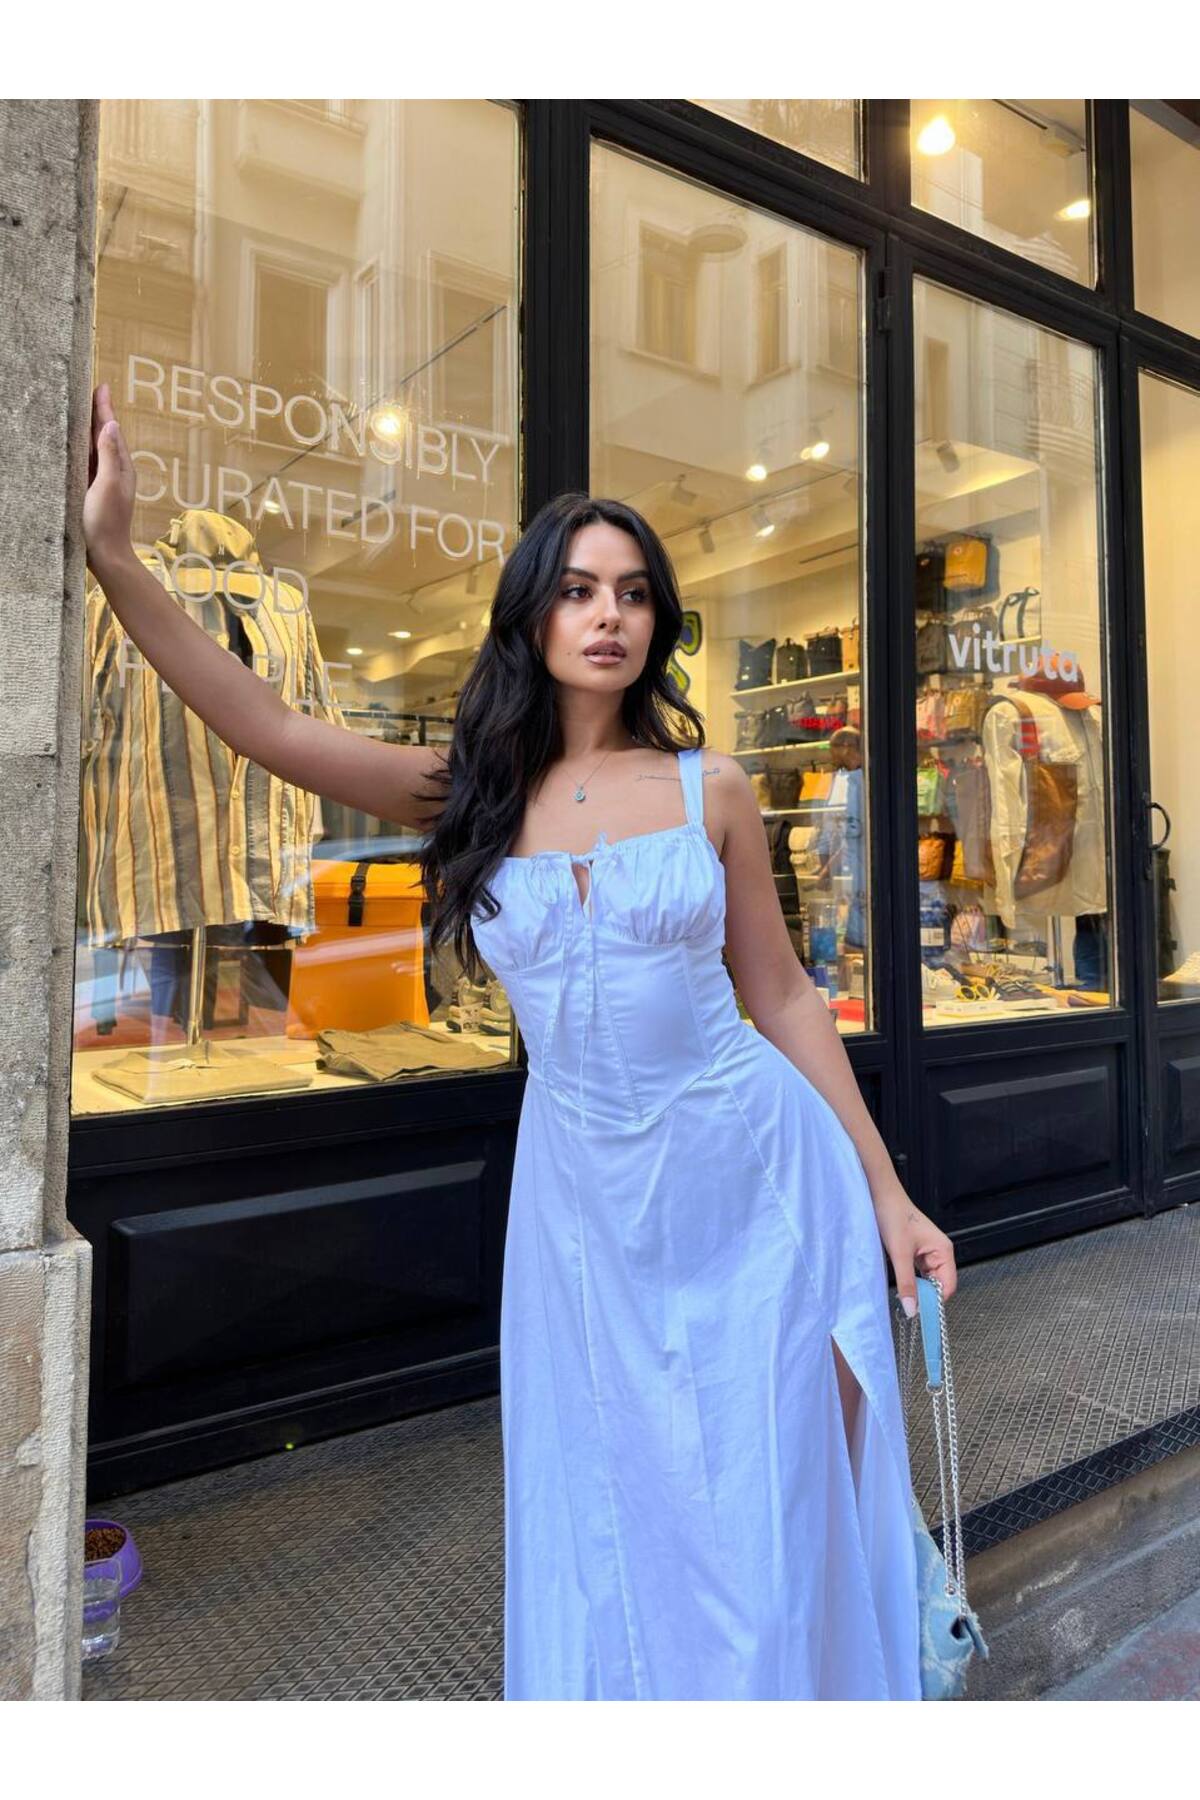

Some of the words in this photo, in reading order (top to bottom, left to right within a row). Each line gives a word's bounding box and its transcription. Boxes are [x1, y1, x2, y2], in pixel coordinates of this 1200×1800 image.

[127, 354, 499, 482] RESPONSIBLY
[130, 450, 394, 544] CURATED
[410, 504, 506, 566] FOR
[948, 622, 1078, 682] vitruta
